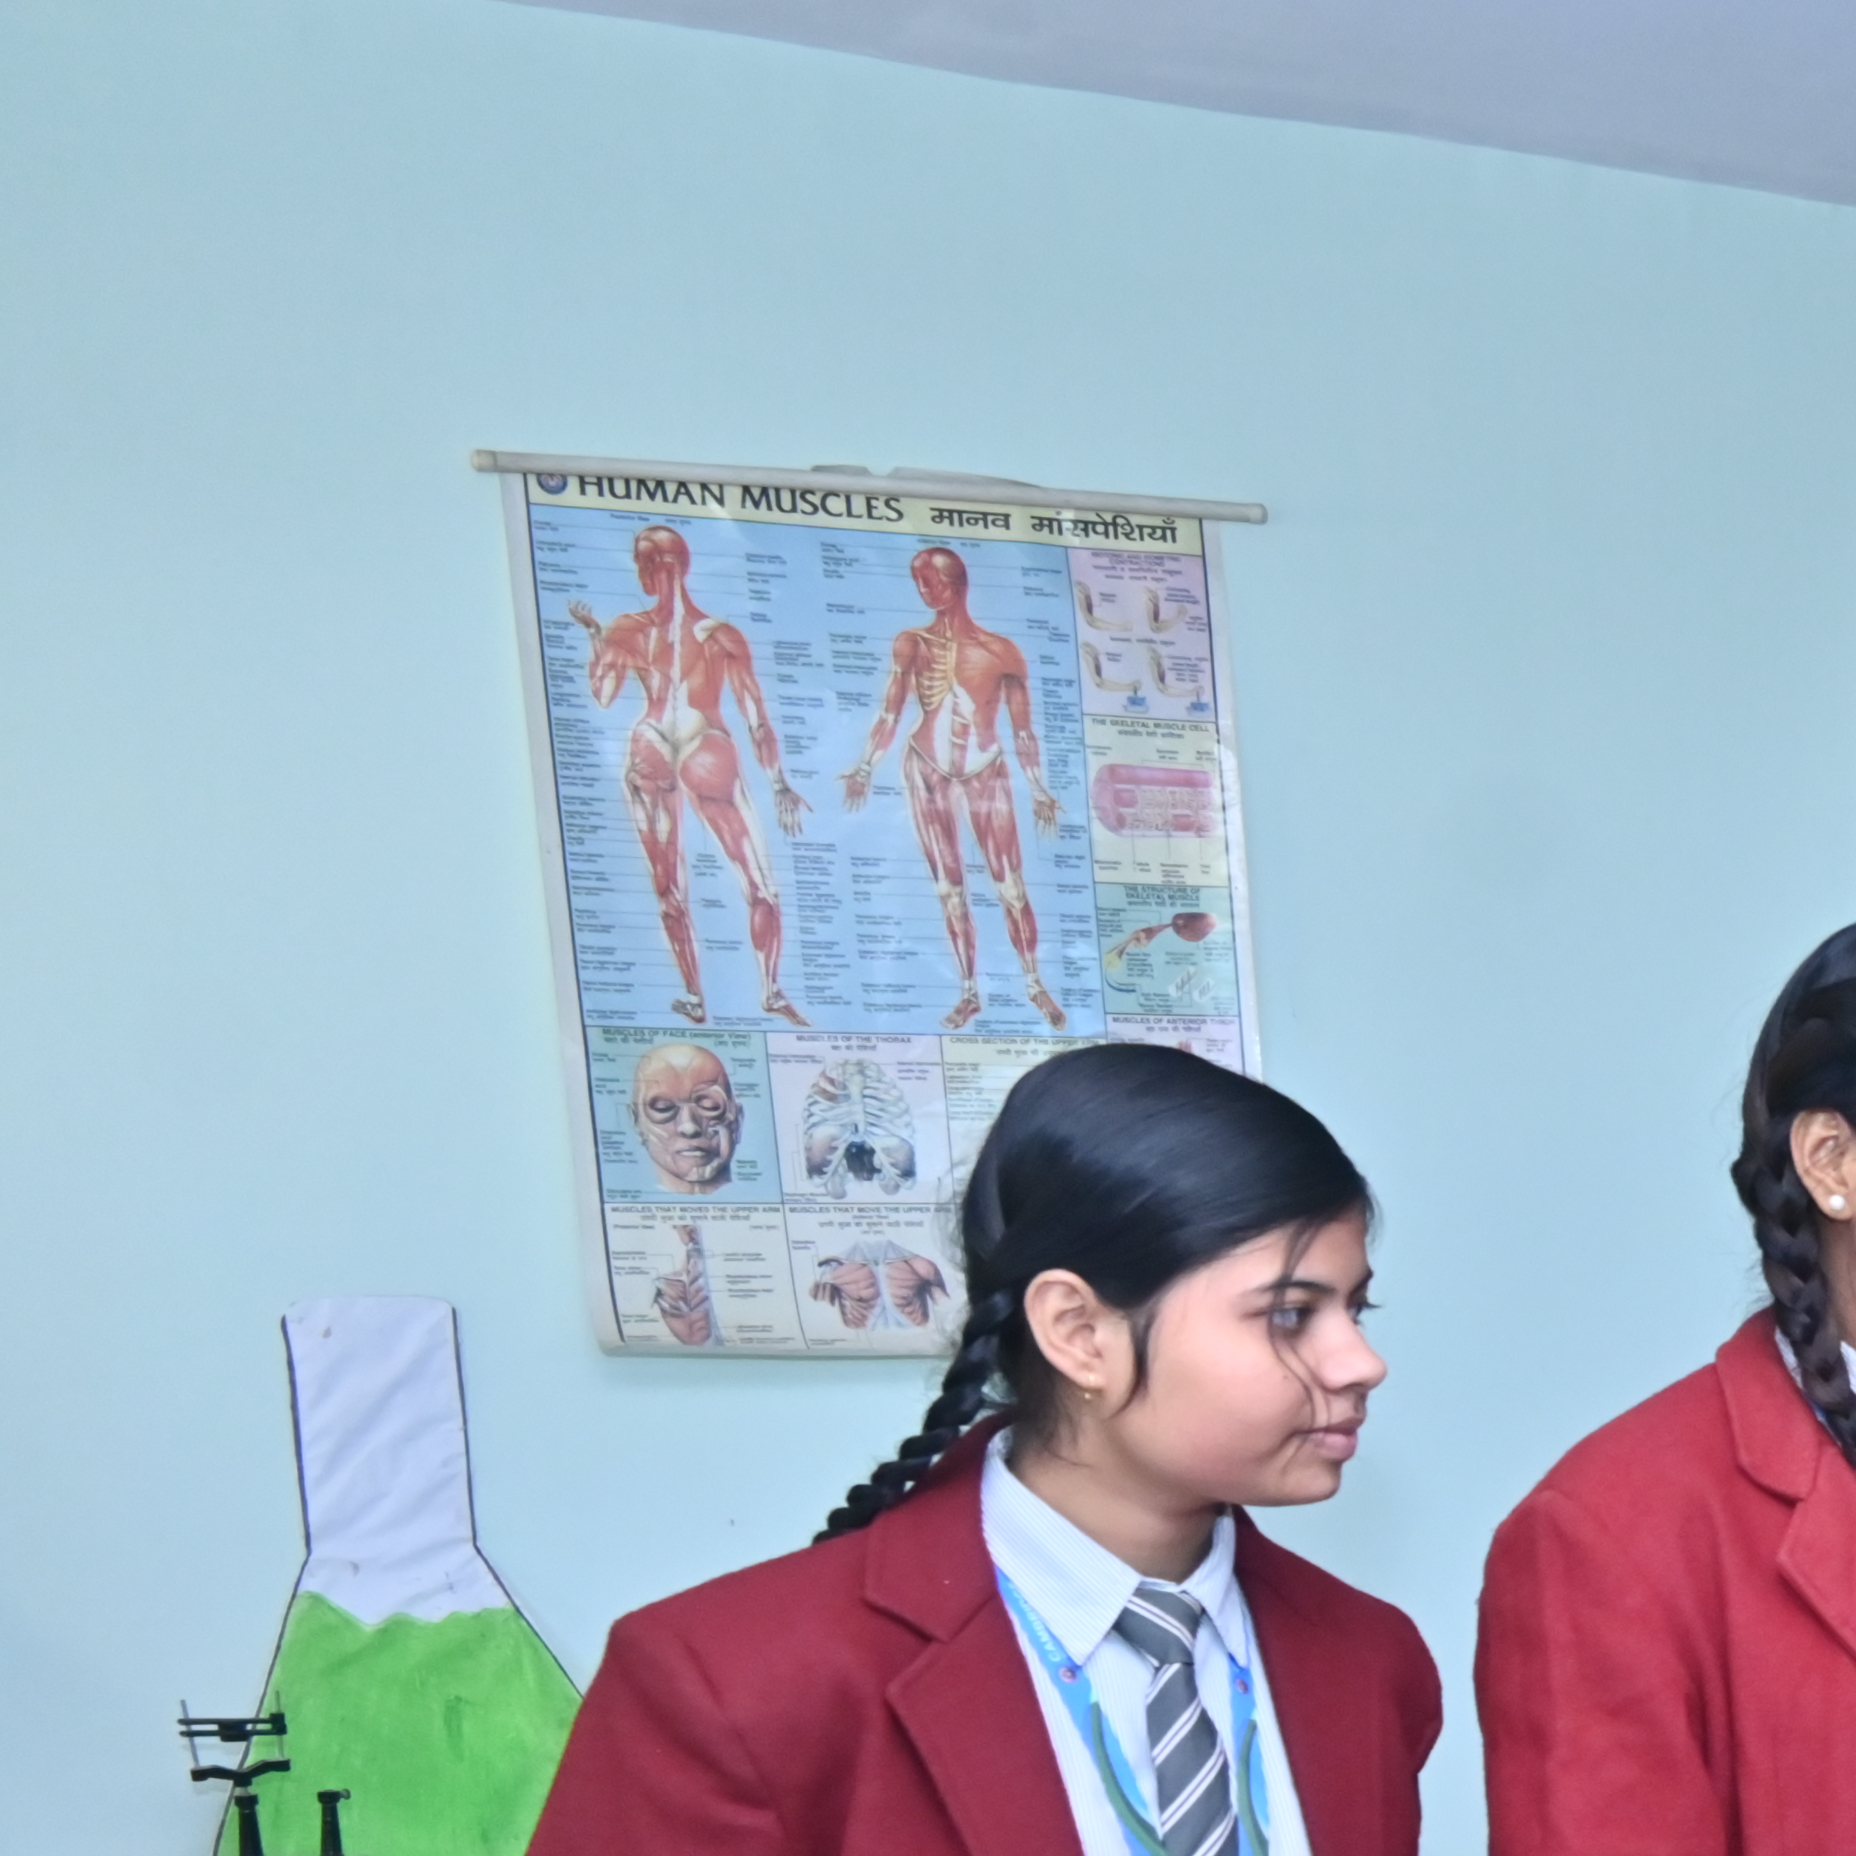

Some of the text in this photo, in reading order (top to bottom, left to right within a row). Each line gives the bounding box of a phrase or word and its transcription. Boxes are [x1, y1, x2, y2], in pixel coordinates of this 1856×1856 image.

[578, 475, 905, 522] HUMAN MUSCLES
[930, 507, 1011, 531] मानव
[796, 1034, 839, 1044] MUSCLES
